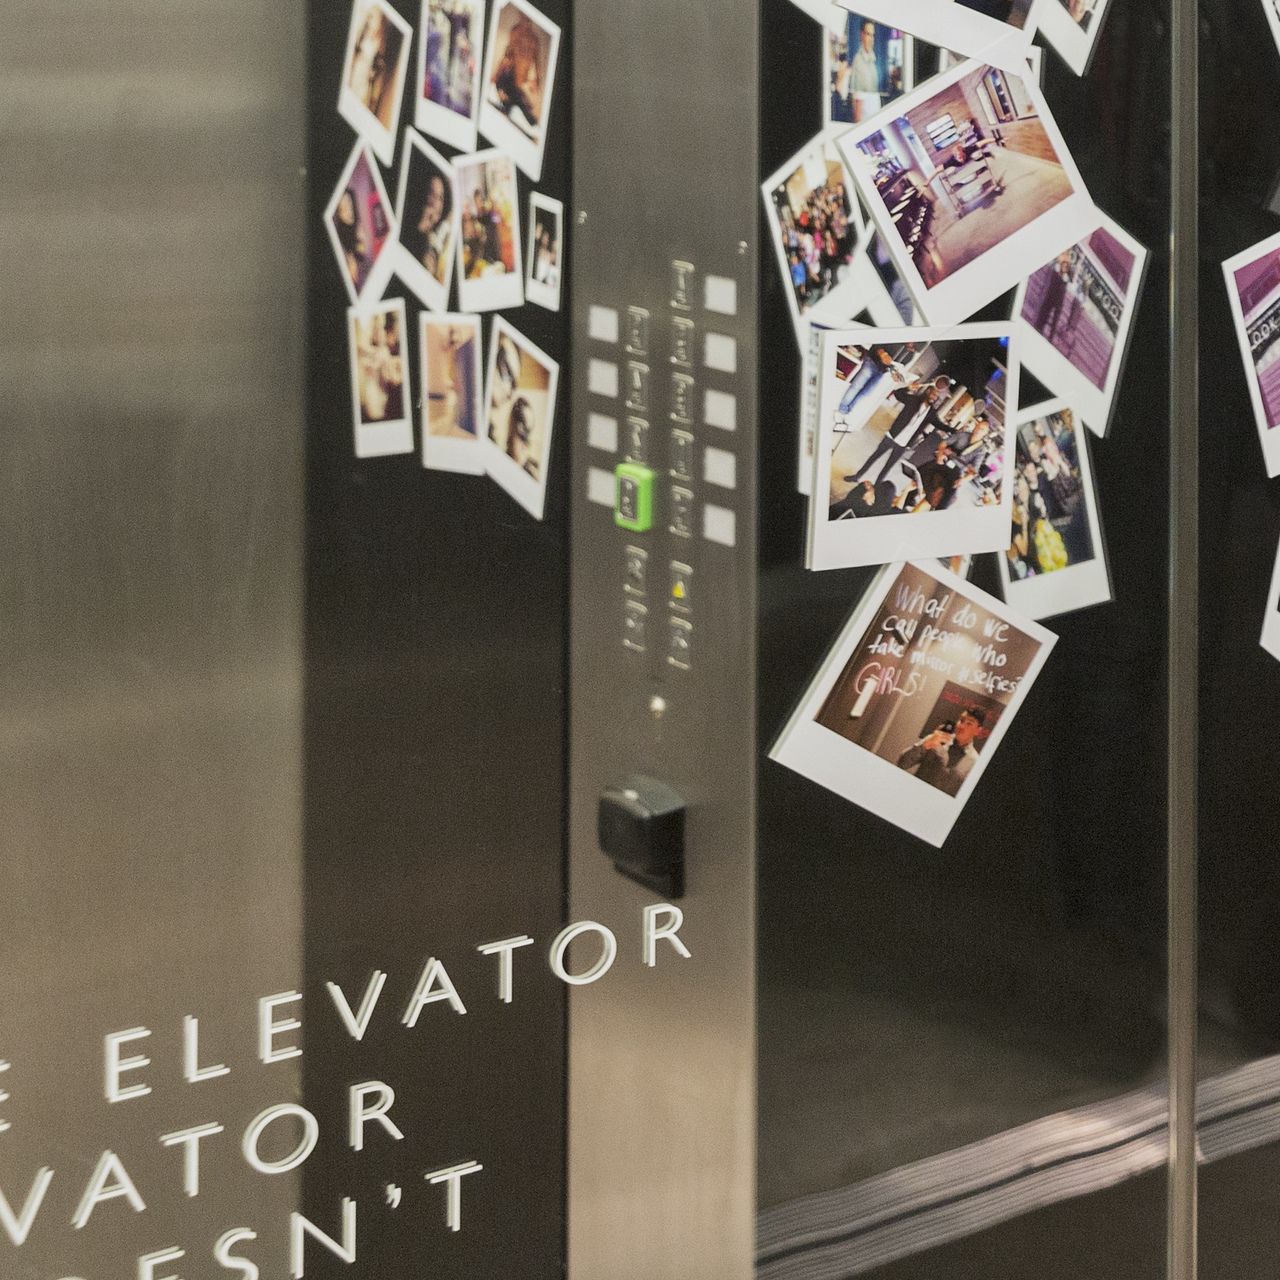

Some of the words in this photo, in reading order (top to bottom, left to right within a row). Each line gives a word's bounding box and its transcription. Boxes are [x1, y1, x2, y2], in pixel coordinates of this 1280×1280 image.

[895, 583, 950, 617] What
[952, 603, 977, 629] do
[983, 617, 1010, 642] we
[867, 634, 905, 658] take
[971, 642, 1008, 667] who
[103, 902, 692, 1103] ELEVATOR
